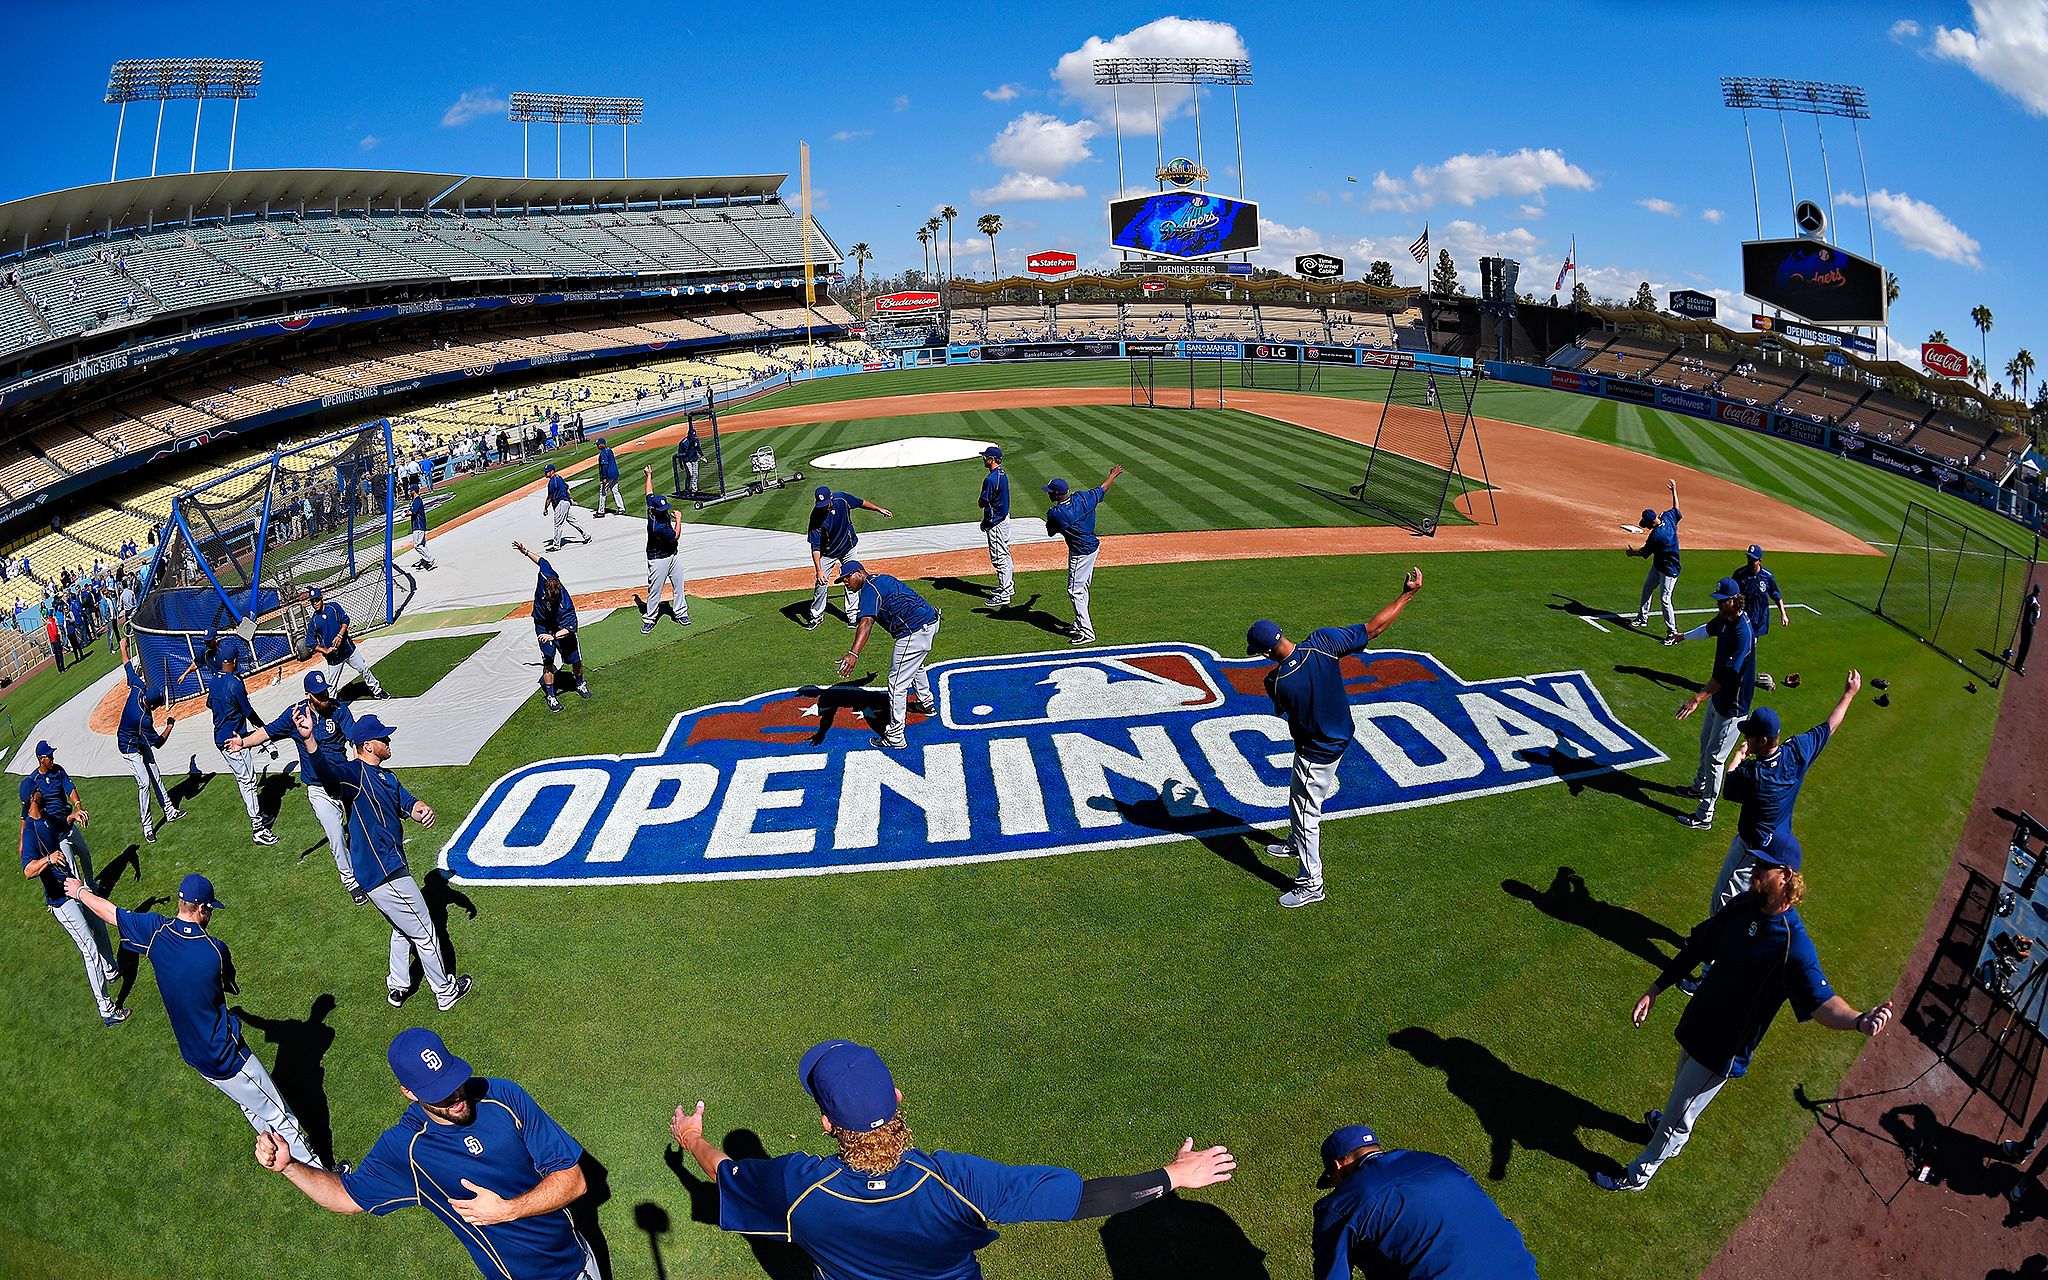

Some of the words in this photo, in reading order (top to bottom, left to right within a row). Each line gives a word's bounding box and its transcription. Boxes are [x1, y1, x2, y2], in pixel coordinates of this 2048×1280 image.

[1160, 211, 1220, 240] Dodgers
[1040, 259, 1057, 267] State
[1157, 265, 1189, 274] OPENING
[1190, 266, 1216, 274] SERIES
[397, 303, 423, 315] OPENING
[424, 301, 442, 312] SERIES
[878, 296, 938, 309] Budweiser
[1686, 296, 1713, 306] SECURITY
[1686, 303, 1711, 312] BENEFIT
[1786, 325, 1818, 340] OPENING
[1818, 332, 1842, 346] SERIES
[1206, 344, 1236, 352] MANUEL
[1271, 347, 1287, 357] LG
[1925, 347, 1964, 372] Coca-Cola
[63, 362, 99, 385] OPENING
[100, 356, 128, 374] SERIES
[321, 391, 354, 408] OPENING
[354, 386, 379, 400] SERIES
[1661, 393, 1704, 410] Southwest
[1723, 404, 1760, 426] Coca-Cola
[1790, 428, 1817, 441] BENEFIT
[1791, 420, 1822, 434] SECURITY
[468, 713, 1340, 868] OPENING
[1350, 680, 1633, 788] DAY
[420, 1048, 443, 1072] SD
[463, 1135, 484, 1156] SD
